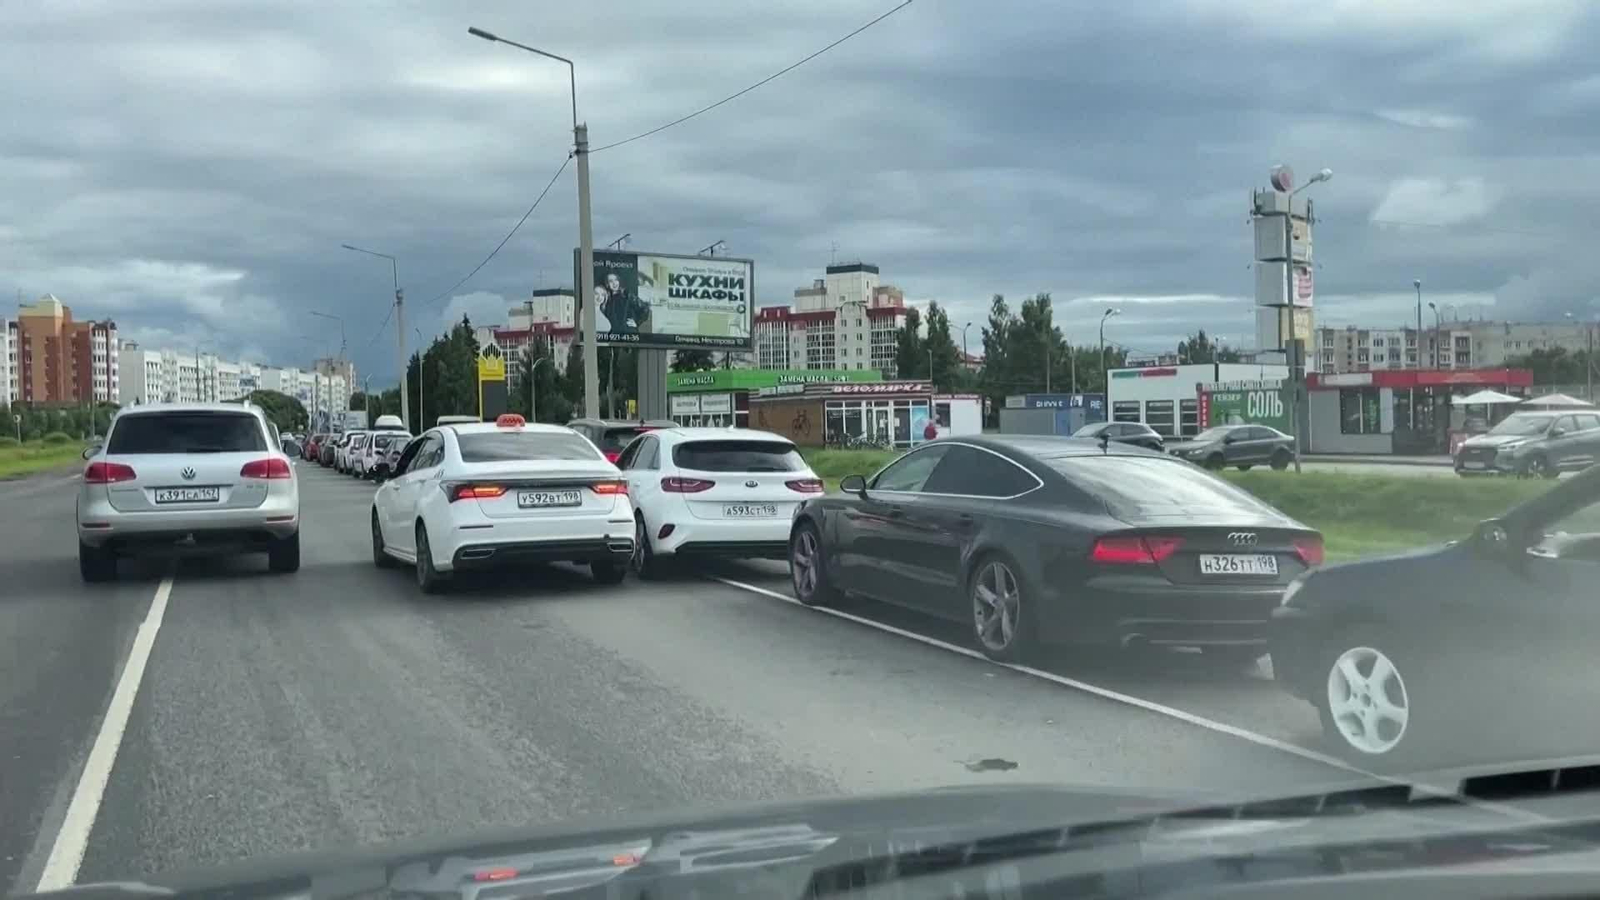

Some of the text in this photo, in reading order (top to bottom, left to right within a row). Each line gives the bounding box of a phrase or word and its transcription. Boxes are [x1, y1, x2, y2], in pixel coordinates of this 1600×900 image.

[668, 273, 744, 289] КУХНИ
[668, 287, 744, 302] ШКАФЫ
[833, 384, 923, 393] ВЕЛОМАРКА
[1247, 391, 1284, 418] СОЛЬ
